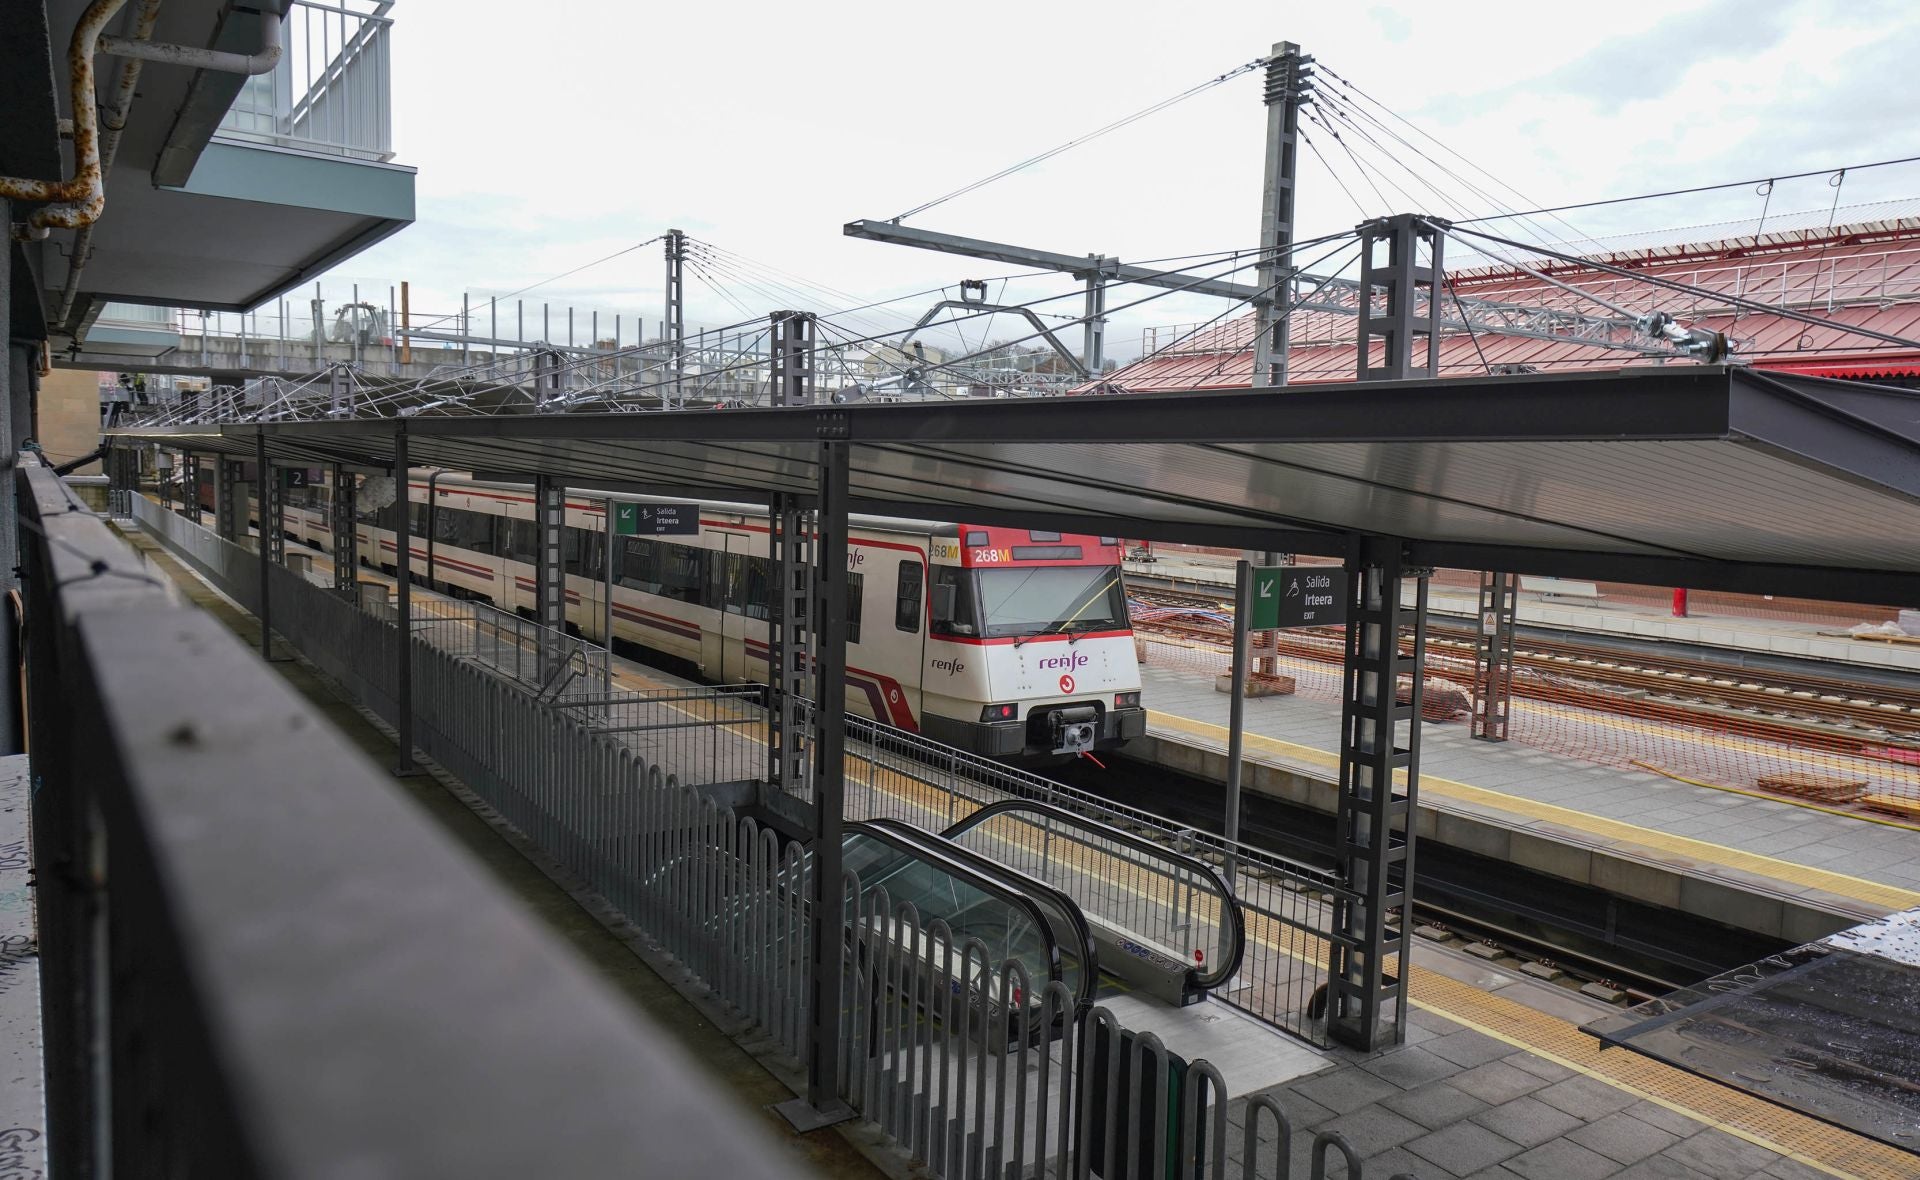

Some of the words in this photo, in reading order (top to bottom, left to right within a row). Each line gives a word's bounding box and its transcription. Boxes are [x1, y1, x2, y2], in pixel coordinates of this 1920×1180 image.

[293, 472, 302, 484] 2
[847, 547, 864, 570] nfe
[975, 548, 1010, 563] 268M
[1306, 575, 1330, 588] Salida
[1305, 594, 1332, 605] Irteera
[1304, 612, 1315, 620] EXIT
[931, 657, 965, 676] renfe
[1039, 650, 1089, 673] renfe
